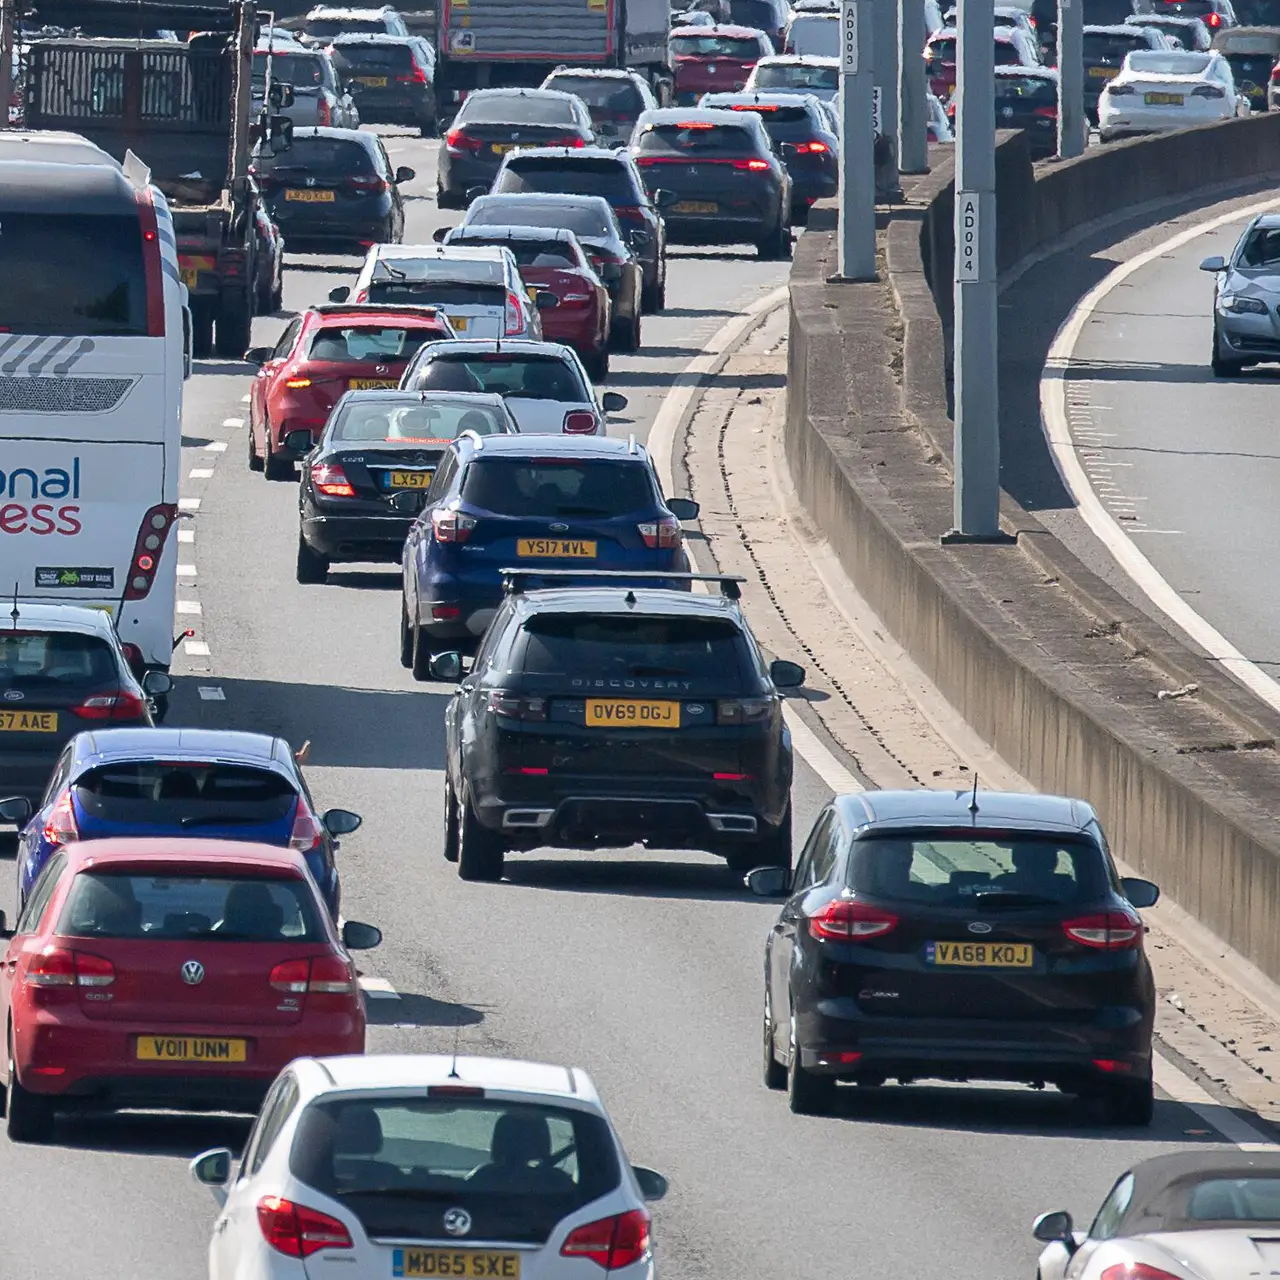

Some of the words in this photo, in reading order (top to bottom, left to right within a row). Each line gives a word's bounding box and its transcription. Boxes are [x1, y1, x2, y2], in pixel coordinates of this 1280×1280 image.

[846, 8, 854, 65] AD003
[964, 201, 975, 272] AD004
[391, 472, 425, 486] LX57
[527, 540, 557, 554] YS17
[571, 679, 692, 690] DISCOVERY
[20, 714, 52, 730] AAE
[939, 944, 987, 963] VA68
[992, 946, 1028, 964] KOJ
[192, 1040, 230, 1059] UNM
[407, 1252, 467, 1276] MD65
[472, 1254, 516, 1277] SXE
